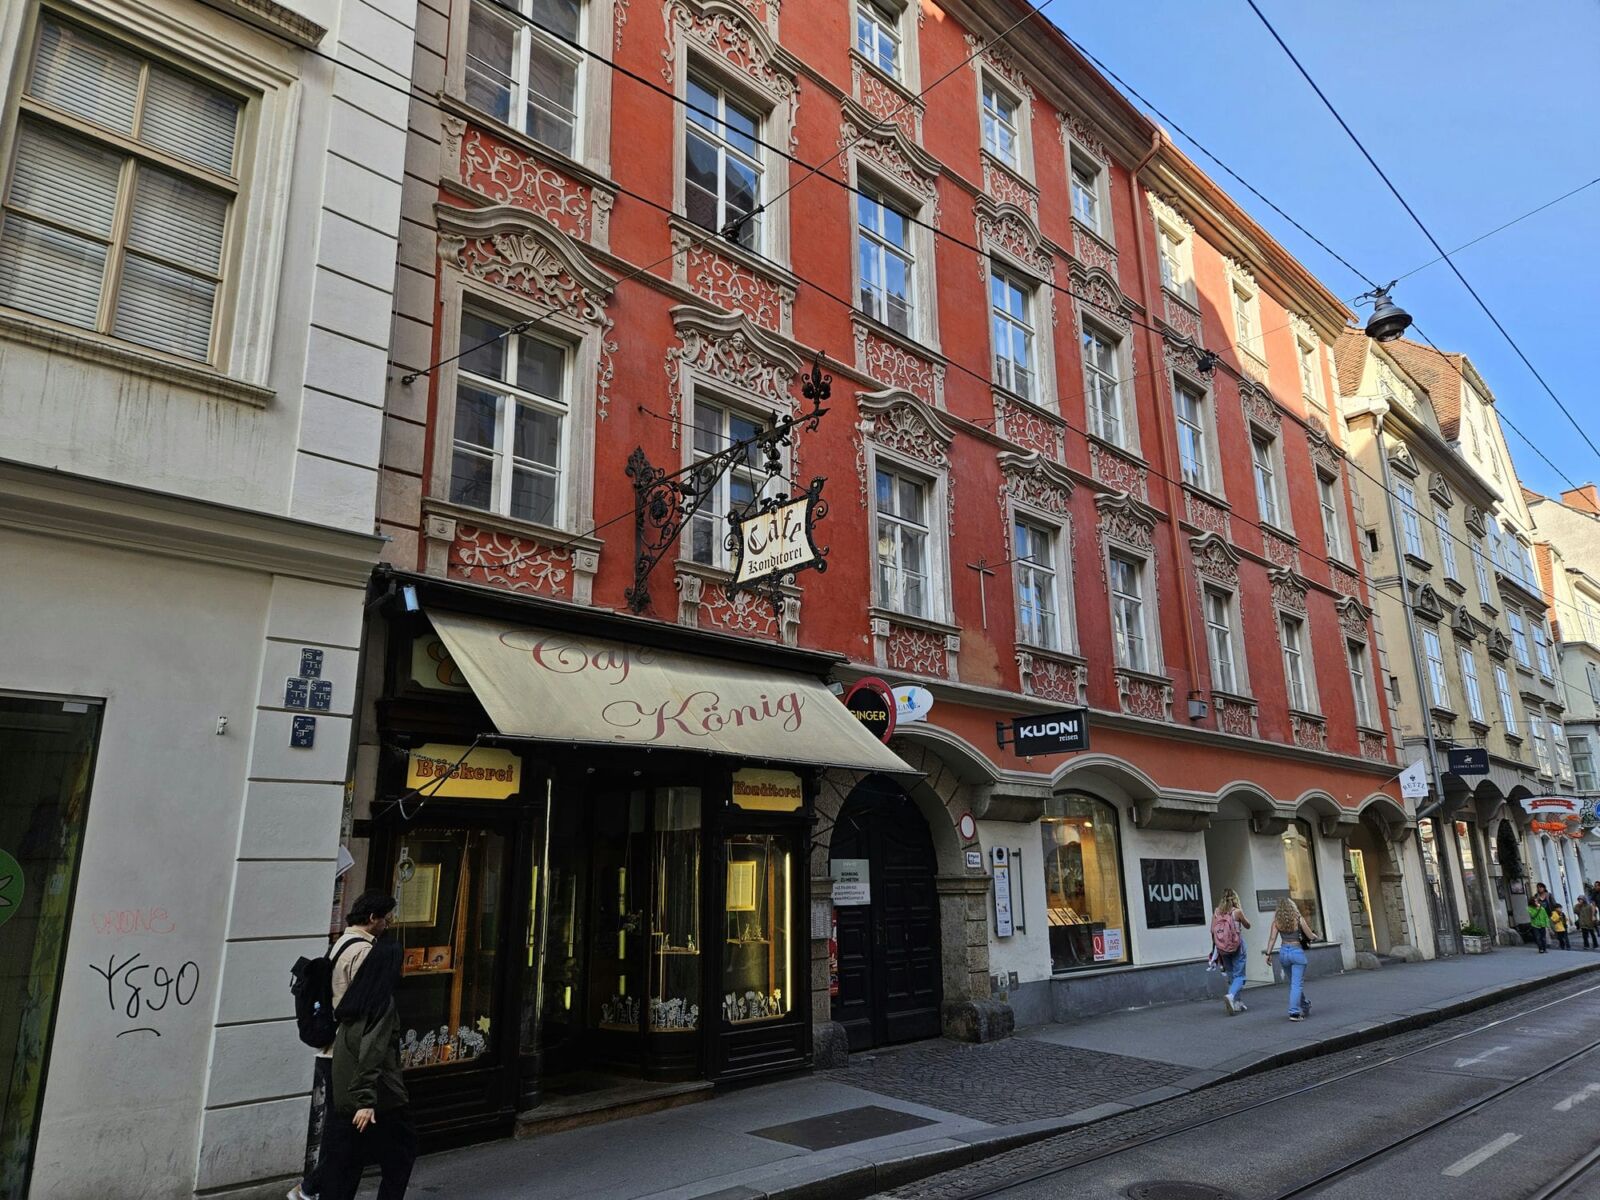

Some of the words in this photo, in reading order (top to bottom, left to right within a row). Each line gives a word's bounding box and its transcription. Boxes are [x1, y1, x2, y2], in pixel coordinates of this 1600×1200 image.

[748, 543, 803, 575] Konditorei
[602, 690, 805, 742] König
[1020, 720, 1079, 739] KUONI
[1059, 733, 1079, 742] reisen
[733, 781, 801, 798] Konditorei
[1148, 883, 1199, 902] KUONI
